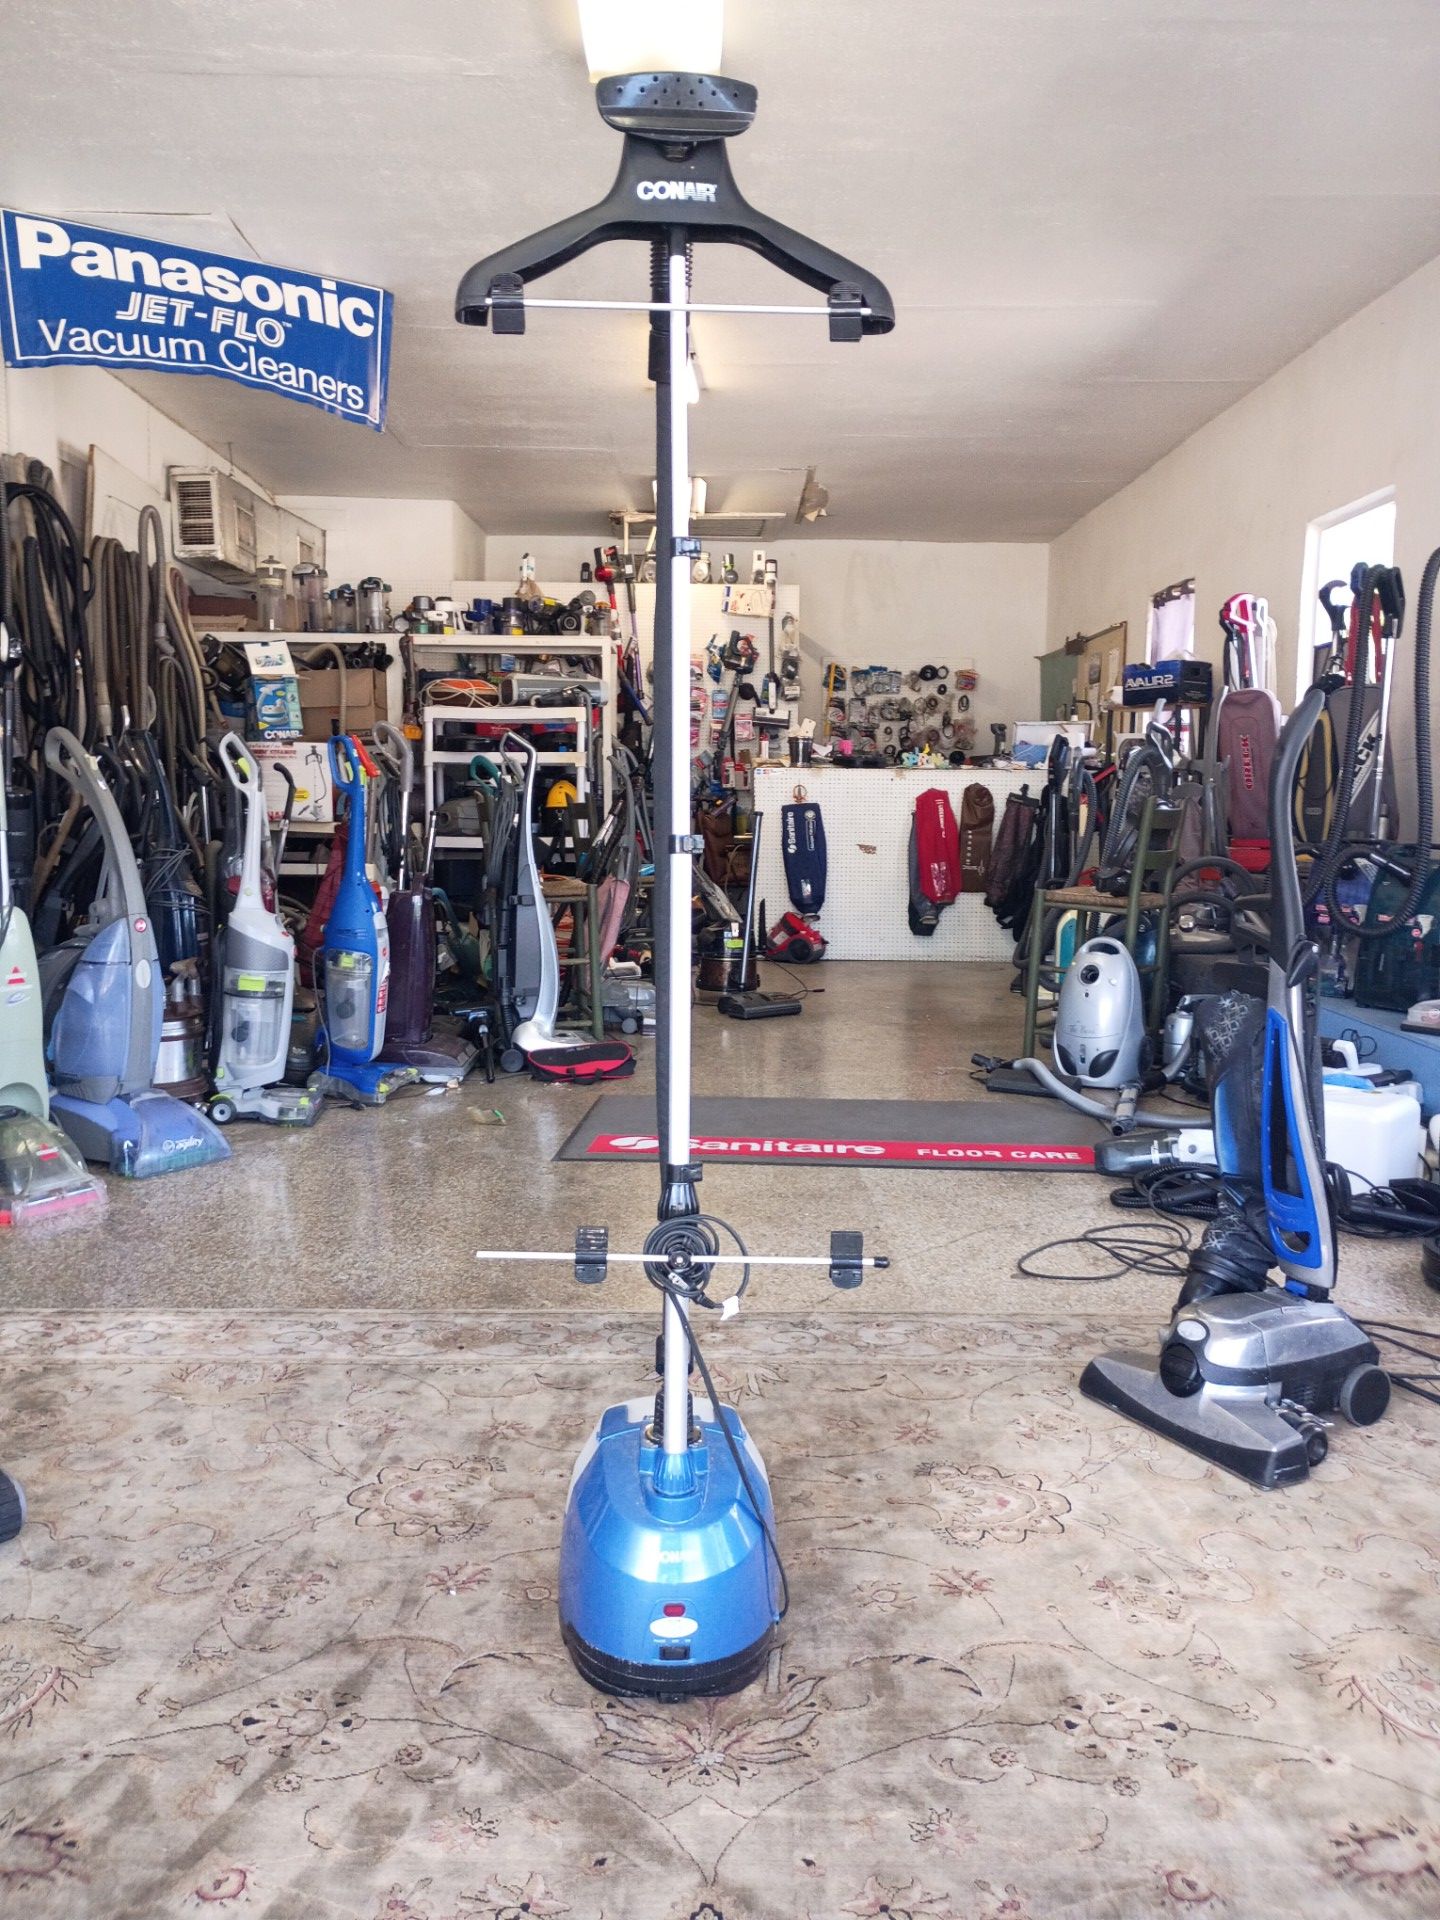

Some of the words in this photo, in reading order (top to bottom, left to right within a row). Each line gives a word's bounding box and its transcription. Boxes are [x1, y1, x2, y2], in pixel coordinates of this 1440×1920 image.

[637, 181, 717, 202] CONAIR
[15, 216, 374, 338] Panasonic
[38, 318, 207, 362] Vacuum
[219, 340, 364, 411] Cleaners
[786, 811, 797, 844] Sanitaire
[1011, 1151, 1082, 1160] CARE
